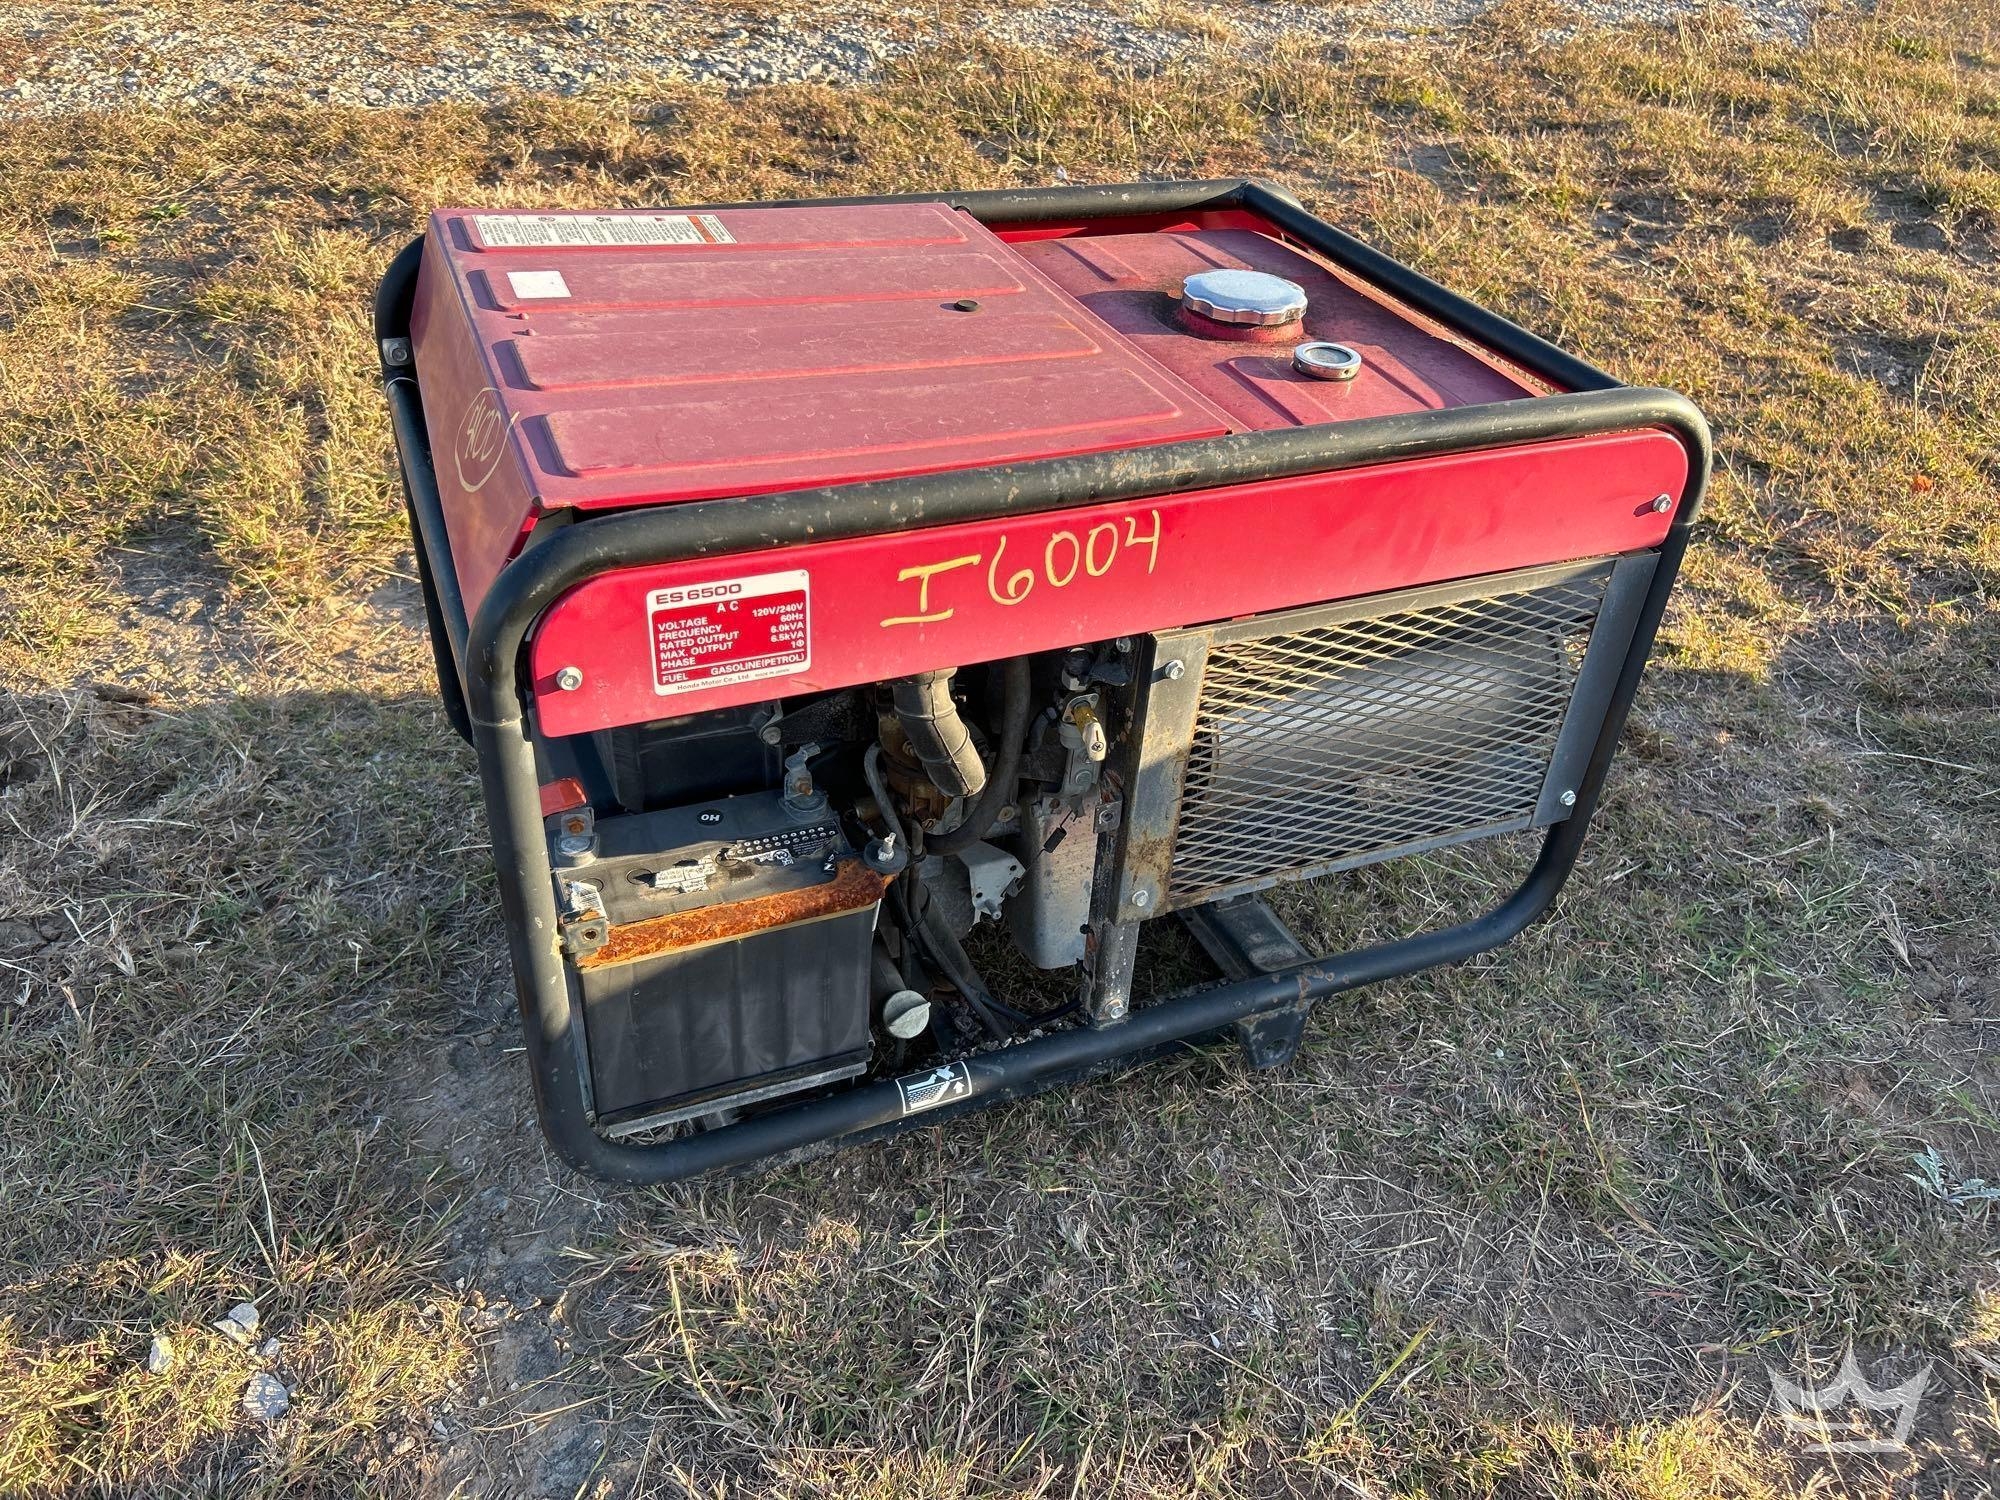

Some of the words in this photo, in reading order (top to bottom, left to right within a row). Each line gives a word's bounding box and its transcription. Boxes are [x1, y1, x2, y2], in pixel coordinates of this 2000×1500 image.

[656, 592, 684, 605] ES
[687, 583, 742, 600] 6500
[658, 616, 708, 632] VOLTAGE
[752, 603, 804, 618] 120V/240V
[659, 624, 723, 642] FREQUENCY
[780, 613, 804, 623] 60Hz
[660, 638, 695, 651] RATED
[697, 631, 740, 645] OUTPUT
[770, 622, 804, 634] 6.0kVA
[660, 647, 688, 661] MAX.
[692, 641, 734, 656] OUTPUT
[770, 631, 804, 643] 6.5kVA
[661, 657, 696, 670] PHASE
[662, 673, 688, 684] FUEL
[710, 652, 805, 676] GASOLINE(PETROL)
[677, 682, 700, 691] Honda
[701, 677, 722, 687] Motor
